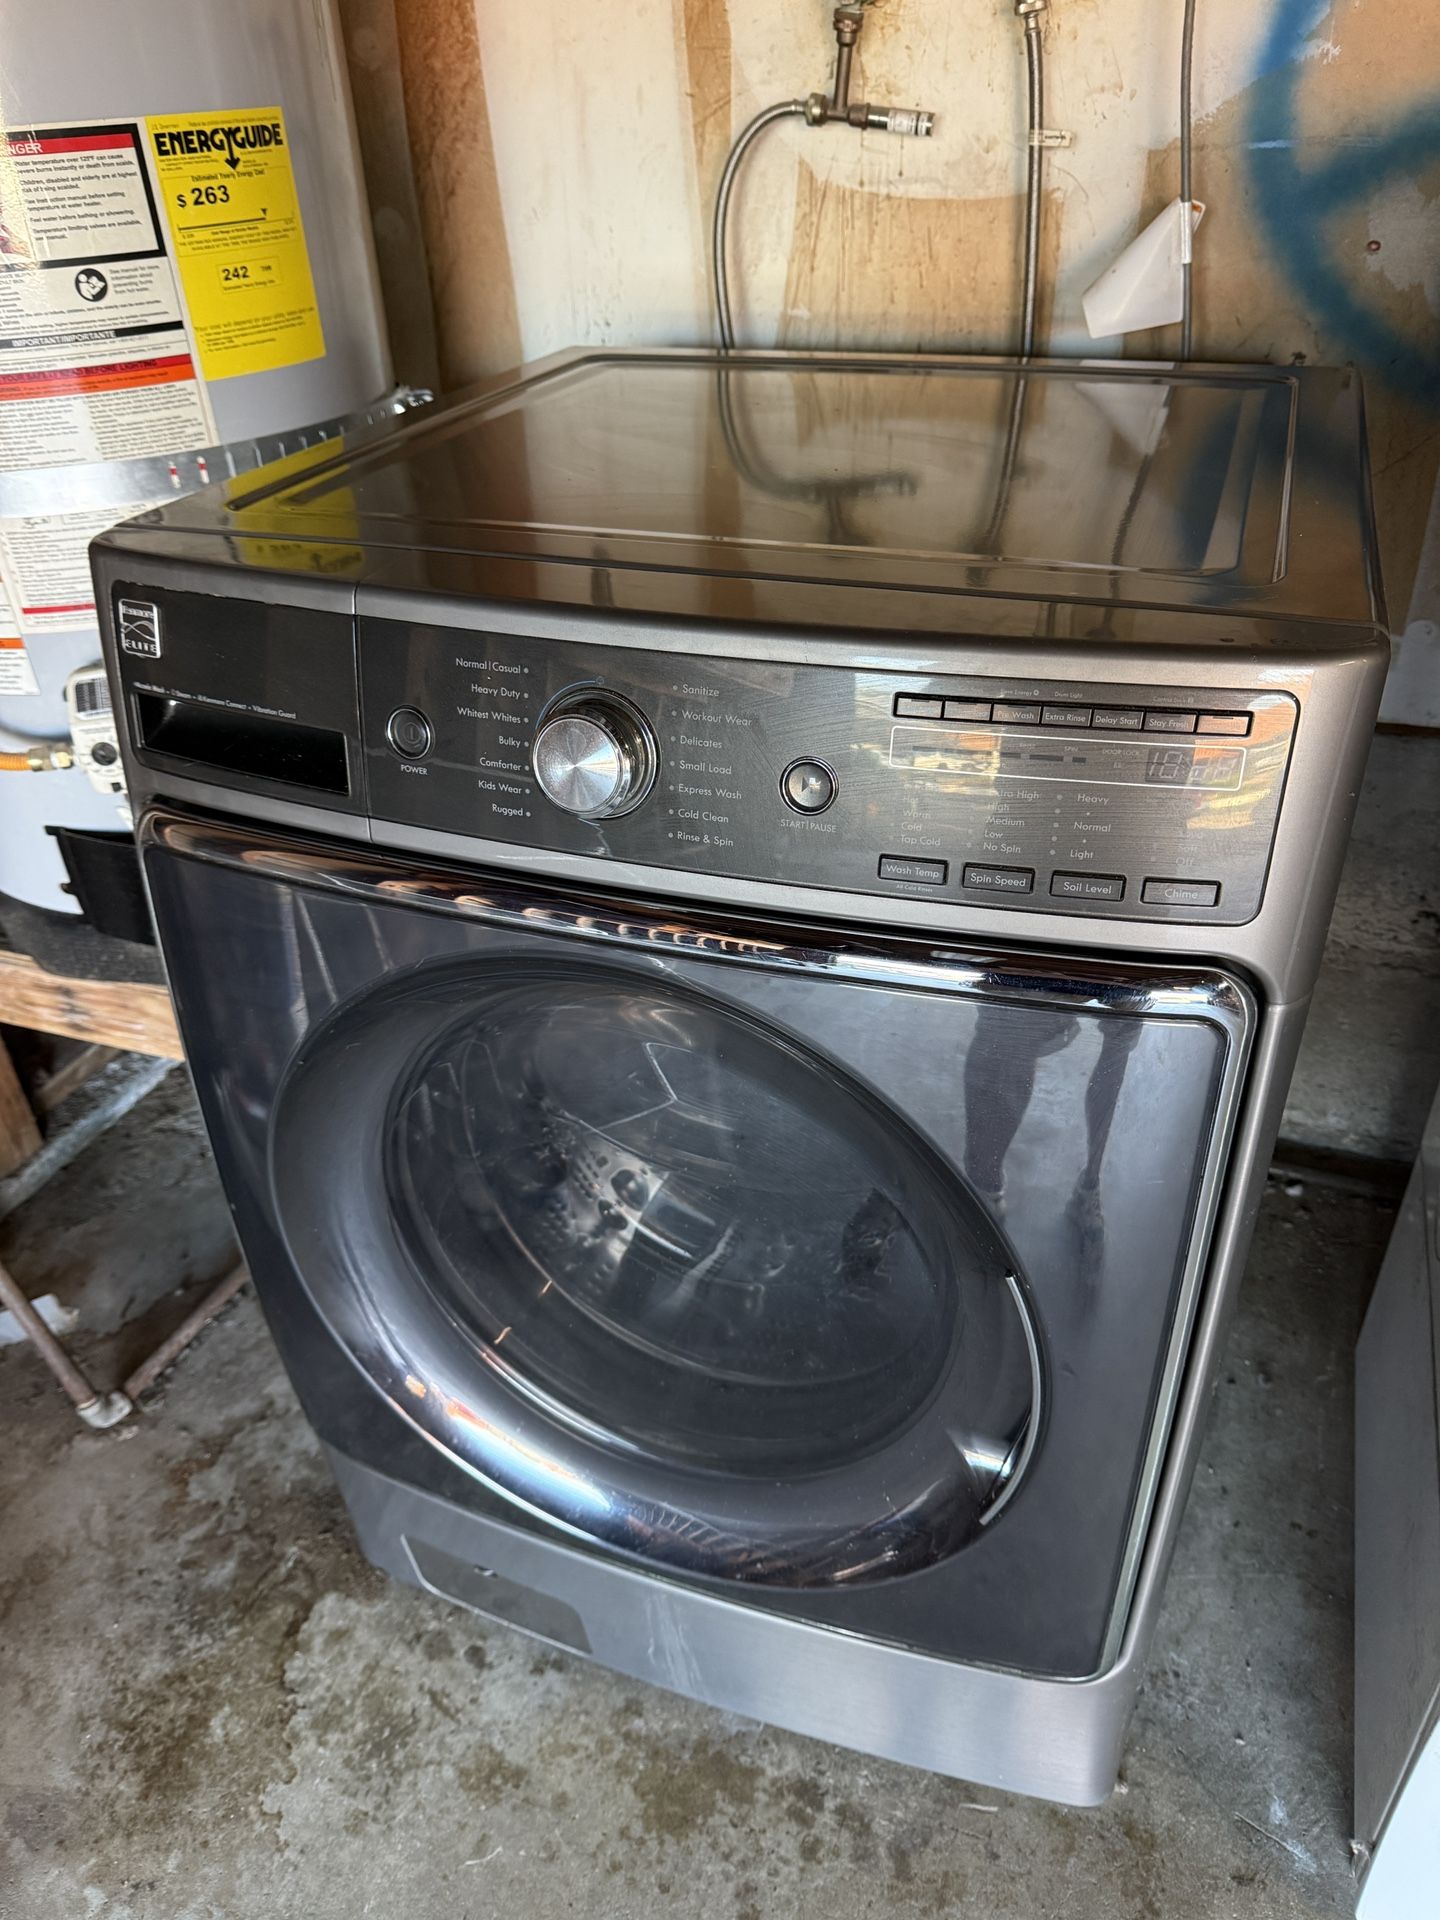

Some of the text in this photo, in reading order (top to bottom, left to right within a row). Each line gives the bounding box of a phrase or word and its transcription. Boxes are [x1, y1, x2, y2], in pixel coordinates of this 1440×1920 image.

[153, 123, 284, 158] ENERGYGUIDE
[191, 184, 230, 206] 263
[222, 265, 250, 281] 242
[125, 639, 156, 653] ELITE
[471, 683, 521, 699] Heavy Duty
[682, 683, 720, 697] Sanitize
[457, 706, 521, 724] Whitest Whites
[681, 709, 753, 726] Workout Wear
[1012, 711, 1034, 720] Wash
[1045, 712, 1086, 722] Extra Rinse
[1095, 714, 1138, 726] Delay Start
[1149, 718, 1167, 728] Stay
[498, 735, 521, 748] Bulky
[680, 735, 722, 749] Delicates
[400, 764, 428, 776] POWER
[479, 757, 521, 771] Comforter
[679, 759, 732, 775] Small Load
[478, 780, 522, 794] Kids Wear
[678, 783, 742, 799] Express Wash
[1016, 789, 1040, 801] High
[1077, 793, 1109, 805] Heavy
[492, 803, 523, 817] Rugged
[677, 808, 729, 823] Cold Clean
[901, 821, 922, 832] Cold
[985, 816, 1025, 827] Medium
[1073, 821, 1111, 833] Normal
[677, 830, 734, 847] Rinse & Spin
[900, 834, 941, 847] Tap Cold
[984, 829, 1004, 838] Low
[983, 842, 1021, 854] No Spin
[1070, 849, 1094, 860] Light
[885, 863, 940, 879] Wash Temp
[970, 872, 1026, 888] Spin Speed
[1063, 881, 1112, 895] Soil Level
[1164, 887, 1198, 900] Chime
